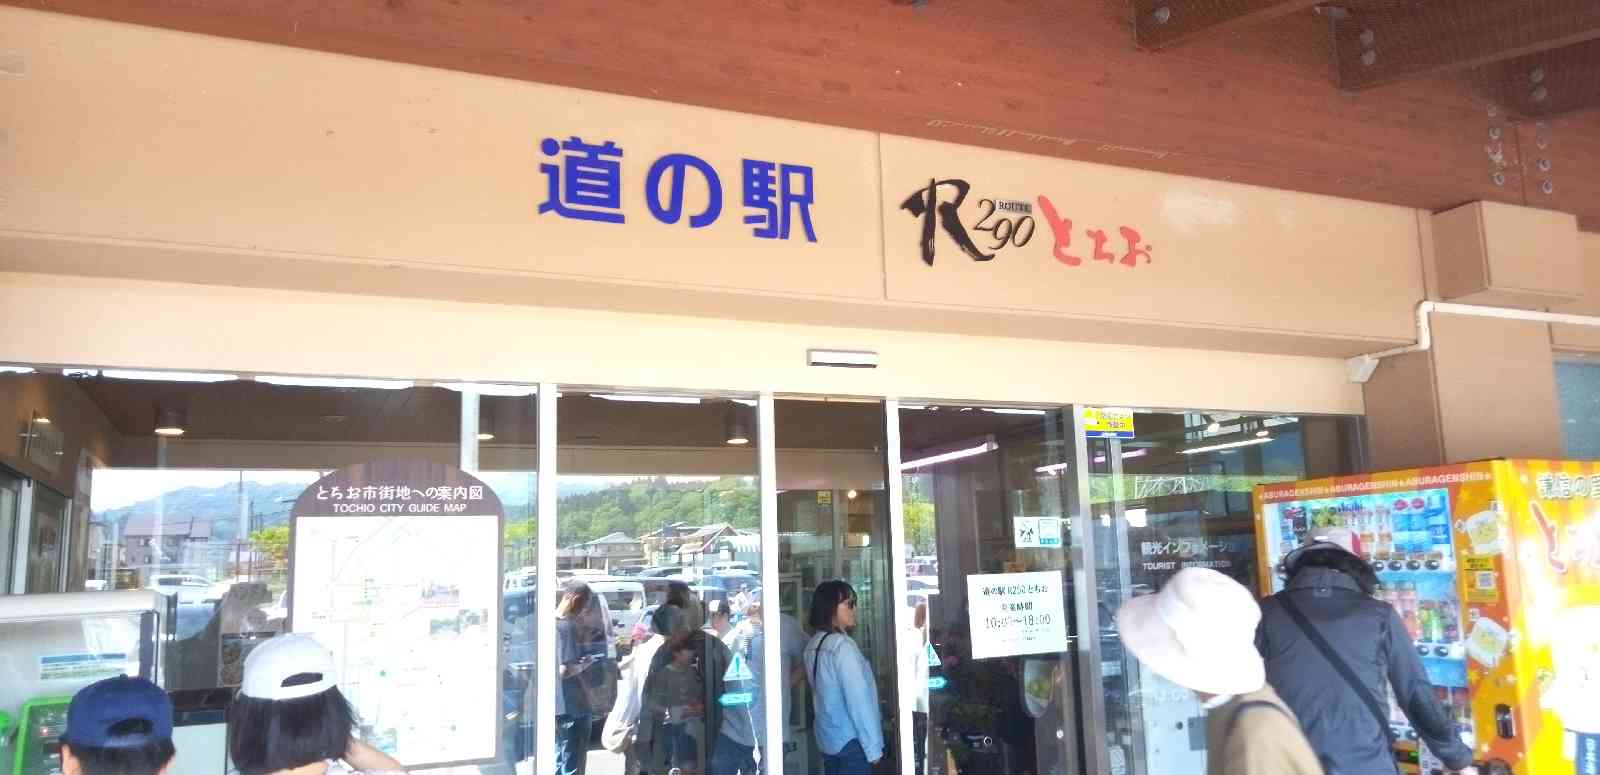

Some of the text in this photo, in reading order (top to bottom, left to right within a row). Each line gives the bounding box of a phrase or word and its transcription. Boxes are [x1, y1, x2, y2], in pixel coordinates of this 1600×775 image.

[538, 136, 817, 243] 道の駅
[1037, 195, 1153, 266] とちお
[316, 485, 483, 500] とちお市街地への案内図
[333, 503, 467, 513] TOCHIO CITY GUIDE MAP
[1143, 561, 1176, 570] TOURIST
